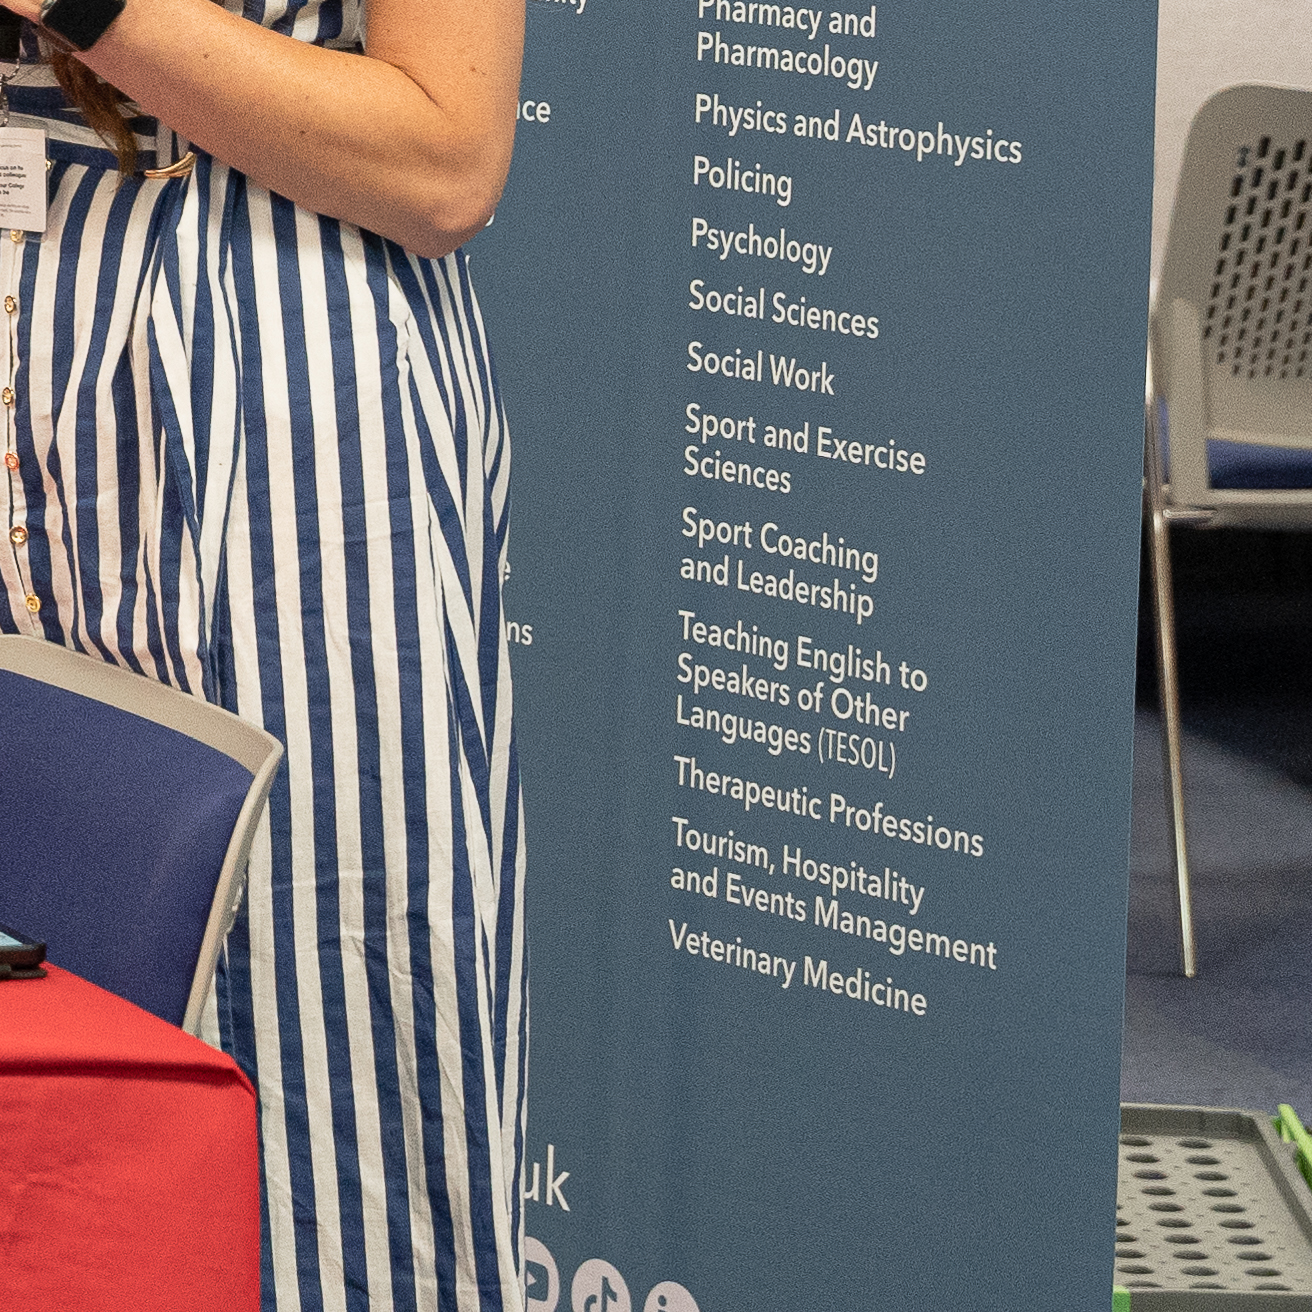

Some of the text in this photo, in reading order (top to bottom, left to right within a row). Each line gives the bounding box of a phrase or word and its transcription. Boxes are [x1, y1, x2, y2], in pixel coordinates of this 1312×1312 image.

[829, 6, 876, 37] and
[698, 32, 878, 90] Pharmacology
[696, 94, 1022, 166] Physics and Astrophysics
[694, 156, 792, 206] Policing
[692, 218, 832, 275] Psychology
[689, 279, 879, 338] Social Sciences
[687, 341, 834, 395] Social Work
[684, 445, 791, 493] Sciences
[685, 403, 926, 474] Sport and Exercise
[682, 507, 878, 583] Sport Coaching
[681, 555, 875, 625] and Leadership
[678, 611, 928, 691] Teaching English to
[677, 653, 910, 731] Speakers of Other
[676, 696, 895, 779] Languages (TESOL)
[674, 755, 983, 856] Therapeutic Professions
[672, 817, 925, 914] Tourism, Hospitality
[671, 867, 997, 969] and Events Management
[669, 919, 927, 1015] Veterinary Medicine
